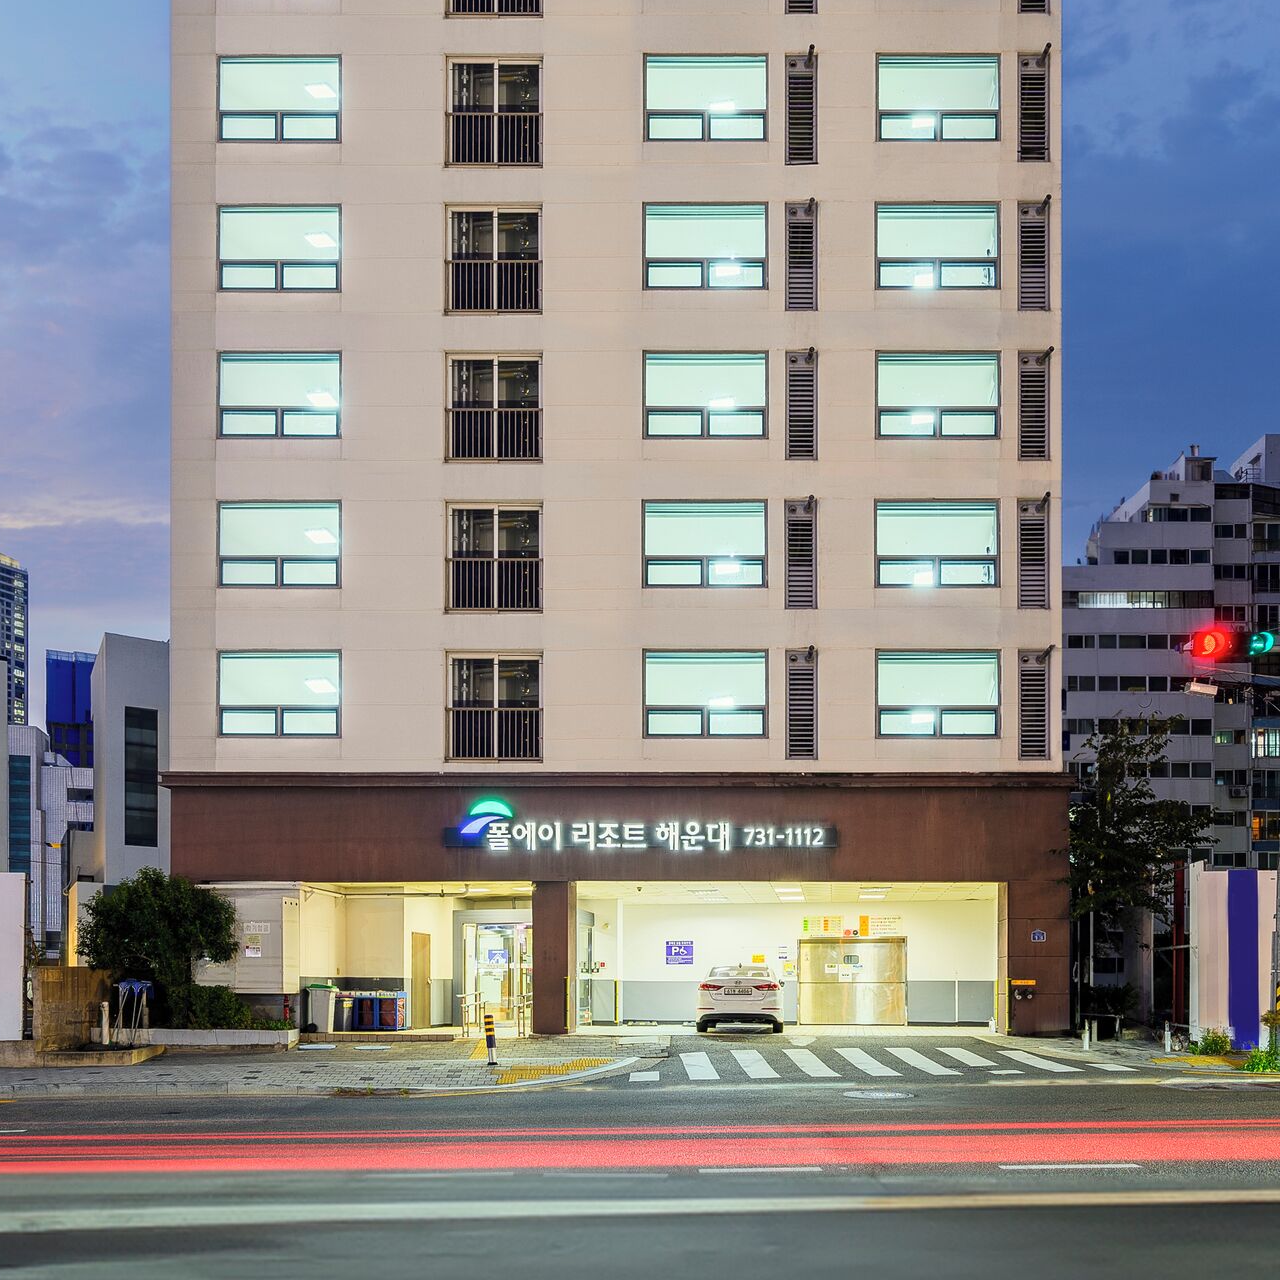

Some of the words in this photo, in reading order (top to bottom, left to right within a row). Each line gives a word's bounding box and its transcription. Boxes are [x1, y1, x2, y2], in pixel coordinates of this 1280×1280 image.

[486, 822, 561, 851] 폴에이
[572, 822, 648, 851] 리조트
[655, 821, 730, 851] 해운대
[743, 827, 825, 846] 731-1112
[672, 946, 680, 956] P
